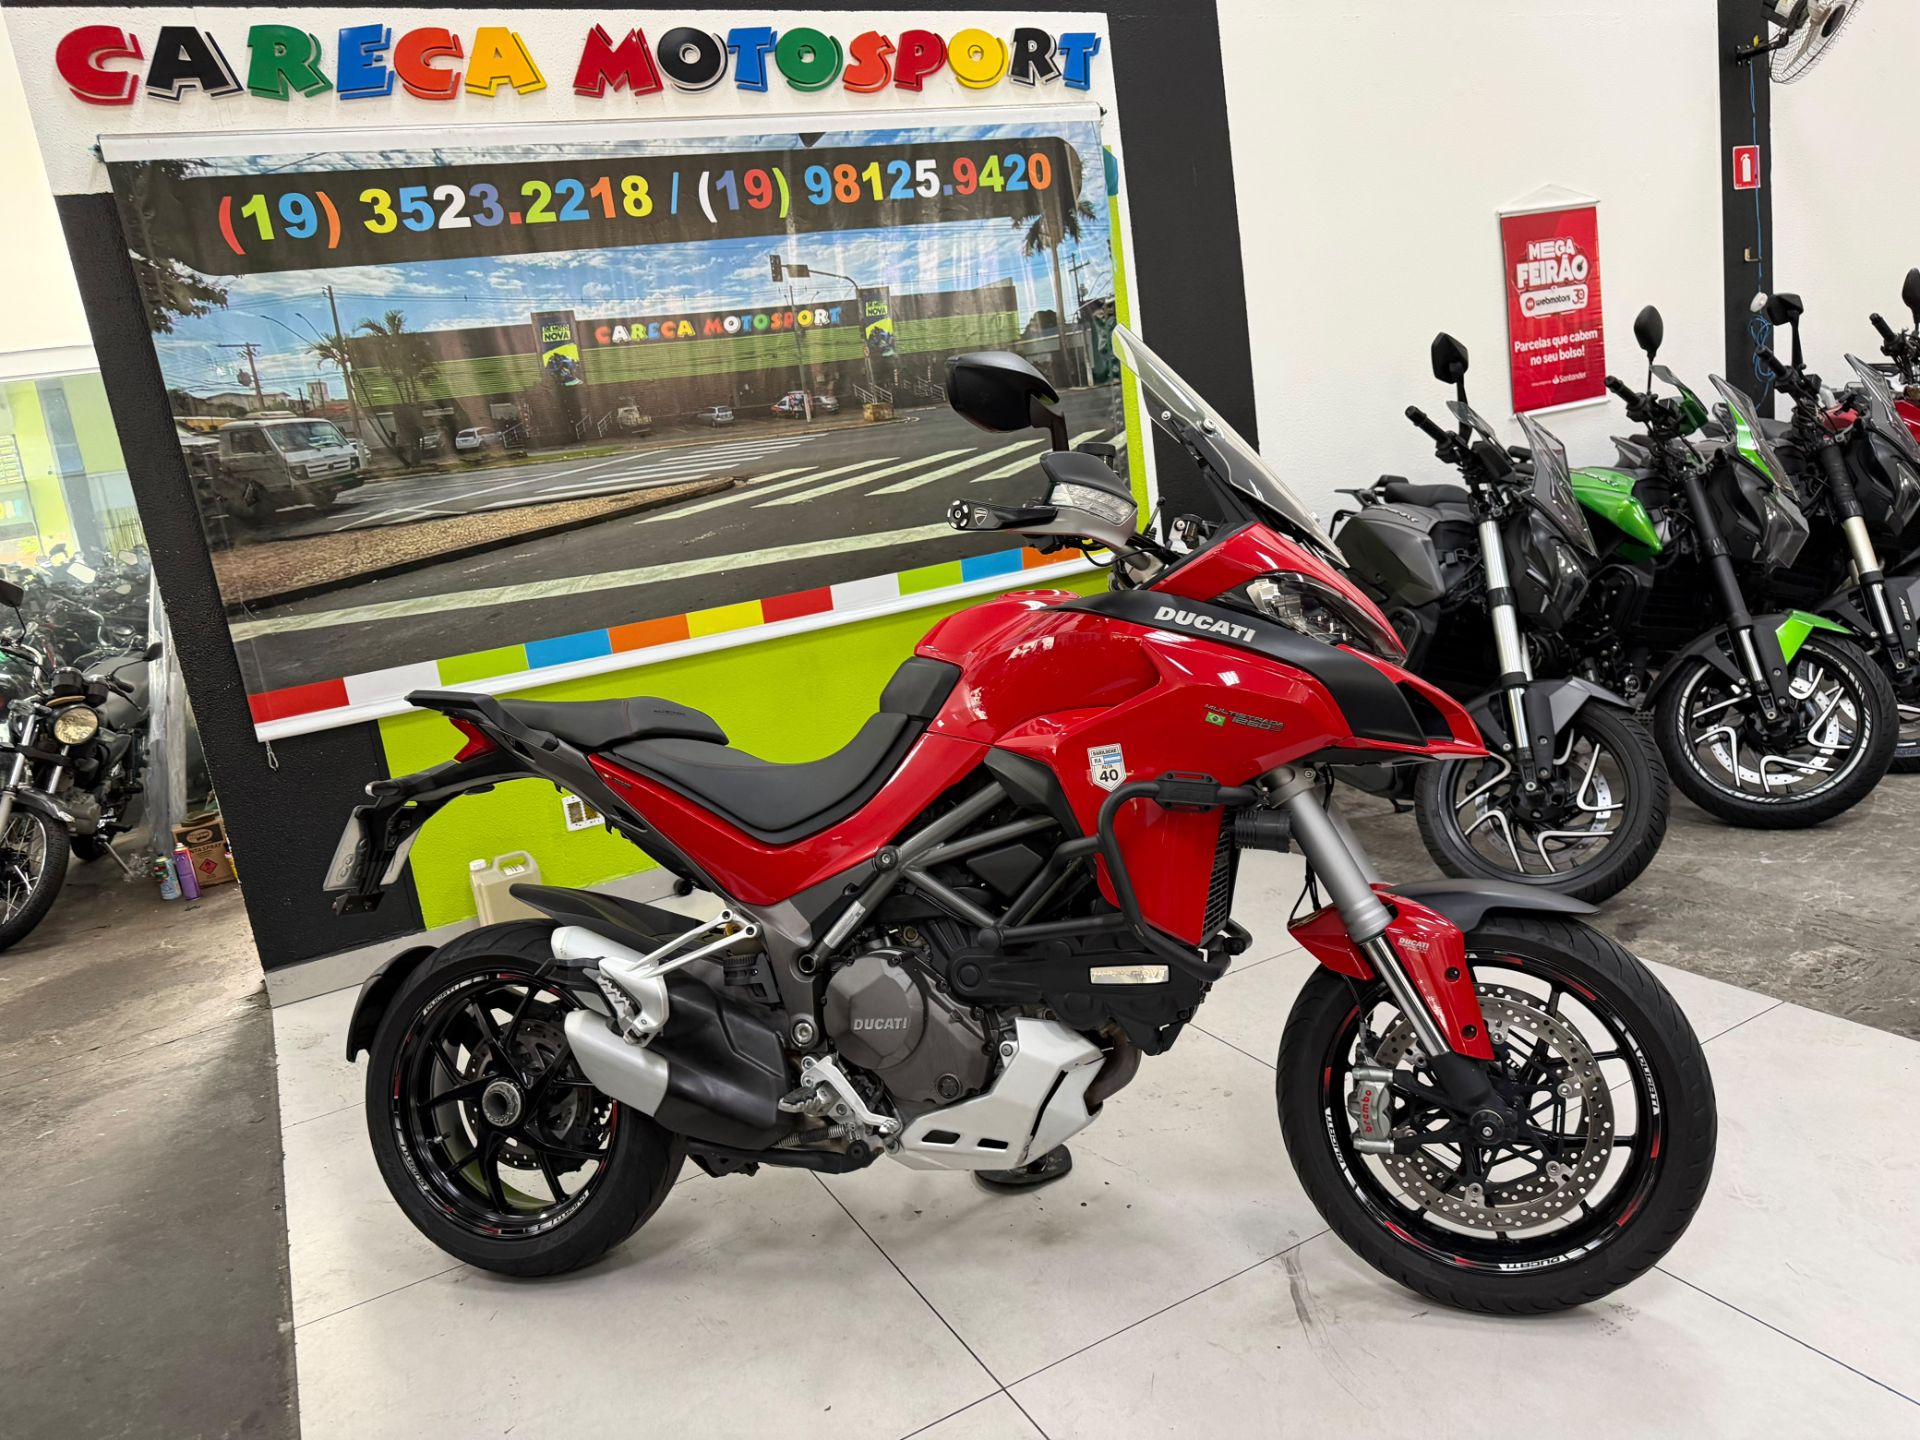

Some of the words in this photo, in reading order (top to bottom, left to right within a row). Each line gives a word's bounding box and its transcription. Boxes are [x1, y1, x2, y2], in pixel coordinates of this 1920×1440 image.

[55, 23, 548, 105] CARECA
[573, 22, 1101, 98] MOTOSPORT
[218, 191, 341, 255] (19)
[363, 176, 653, 234] 3523.2218
[699, 167, 790, 223] (19)
[805, 152, 1052, 206] 98125.9420
[1528, 238, 1576, 260] MEGA
[1516, 254, 1588, 289] FEIRÃO
[1536, 294, 1571, 307] webmotors
[544, 331, 569, 341] NOVA
[594, 320, 697, 345] CARECA
[704, 307, 842, 336] MOTOSPORT
[1514, 336, 1551, 353] Parcelas
[1552, 334, 1568, 348] que
[1569, 329, 1598, 343] cabem
[1530, 355, 1542, 366] no
[1543, 352, 1558, 364] seu
[1558, 344, 1585, 361] bolso!
[1559, 372, 1587, 383] Santander
[1153, 605, 1256, 643] DUCATI
[1100, 769, 1119, 782] 40
[1398, 936, 1430, 949] DUCATI
[853, 1016, 908, 1030] DUCATI
[1361, 1089, 1373, 1133] brembo
